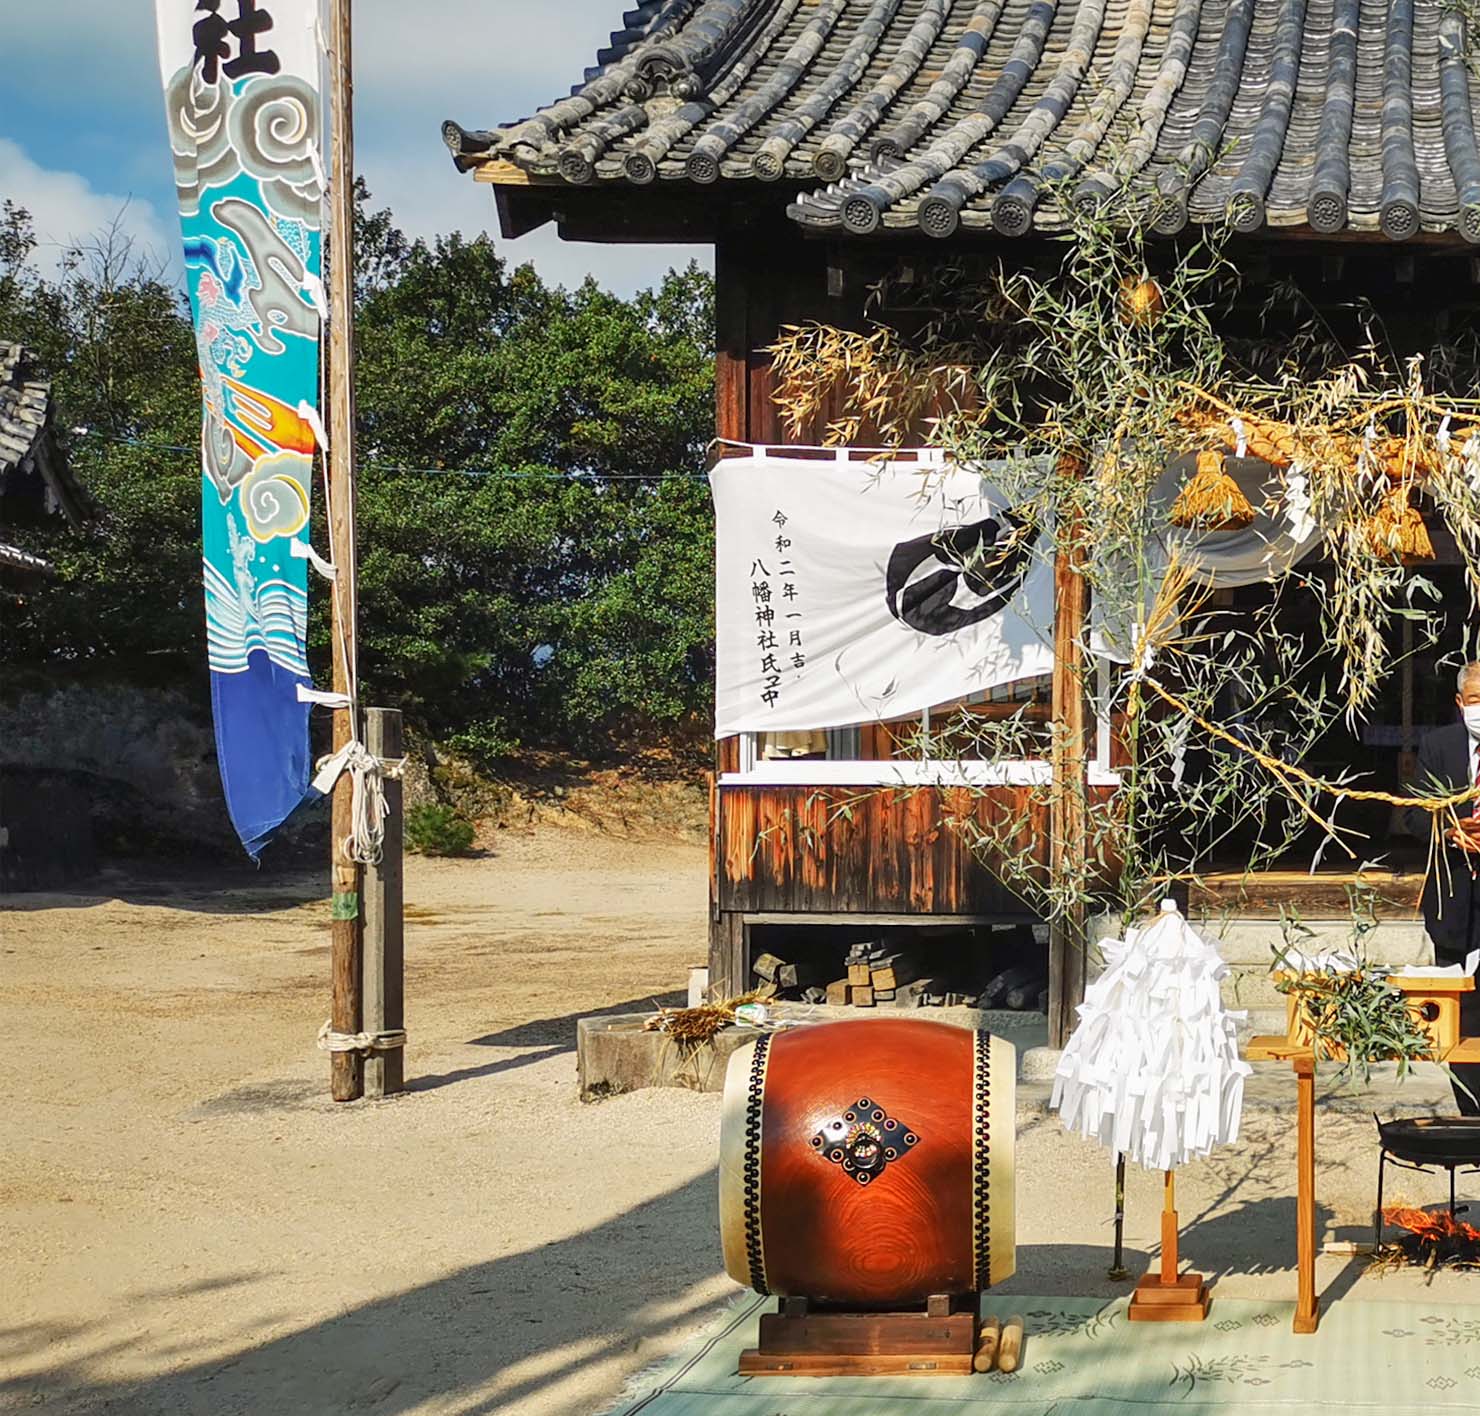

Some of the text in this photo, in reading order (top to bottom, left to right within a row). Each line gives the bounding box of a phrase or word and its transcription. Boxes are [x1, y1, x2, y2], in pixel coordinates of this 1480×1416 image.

[192, 0, 281, 85] 社
[772, 510, 806, 679] 令和二年一月吉
